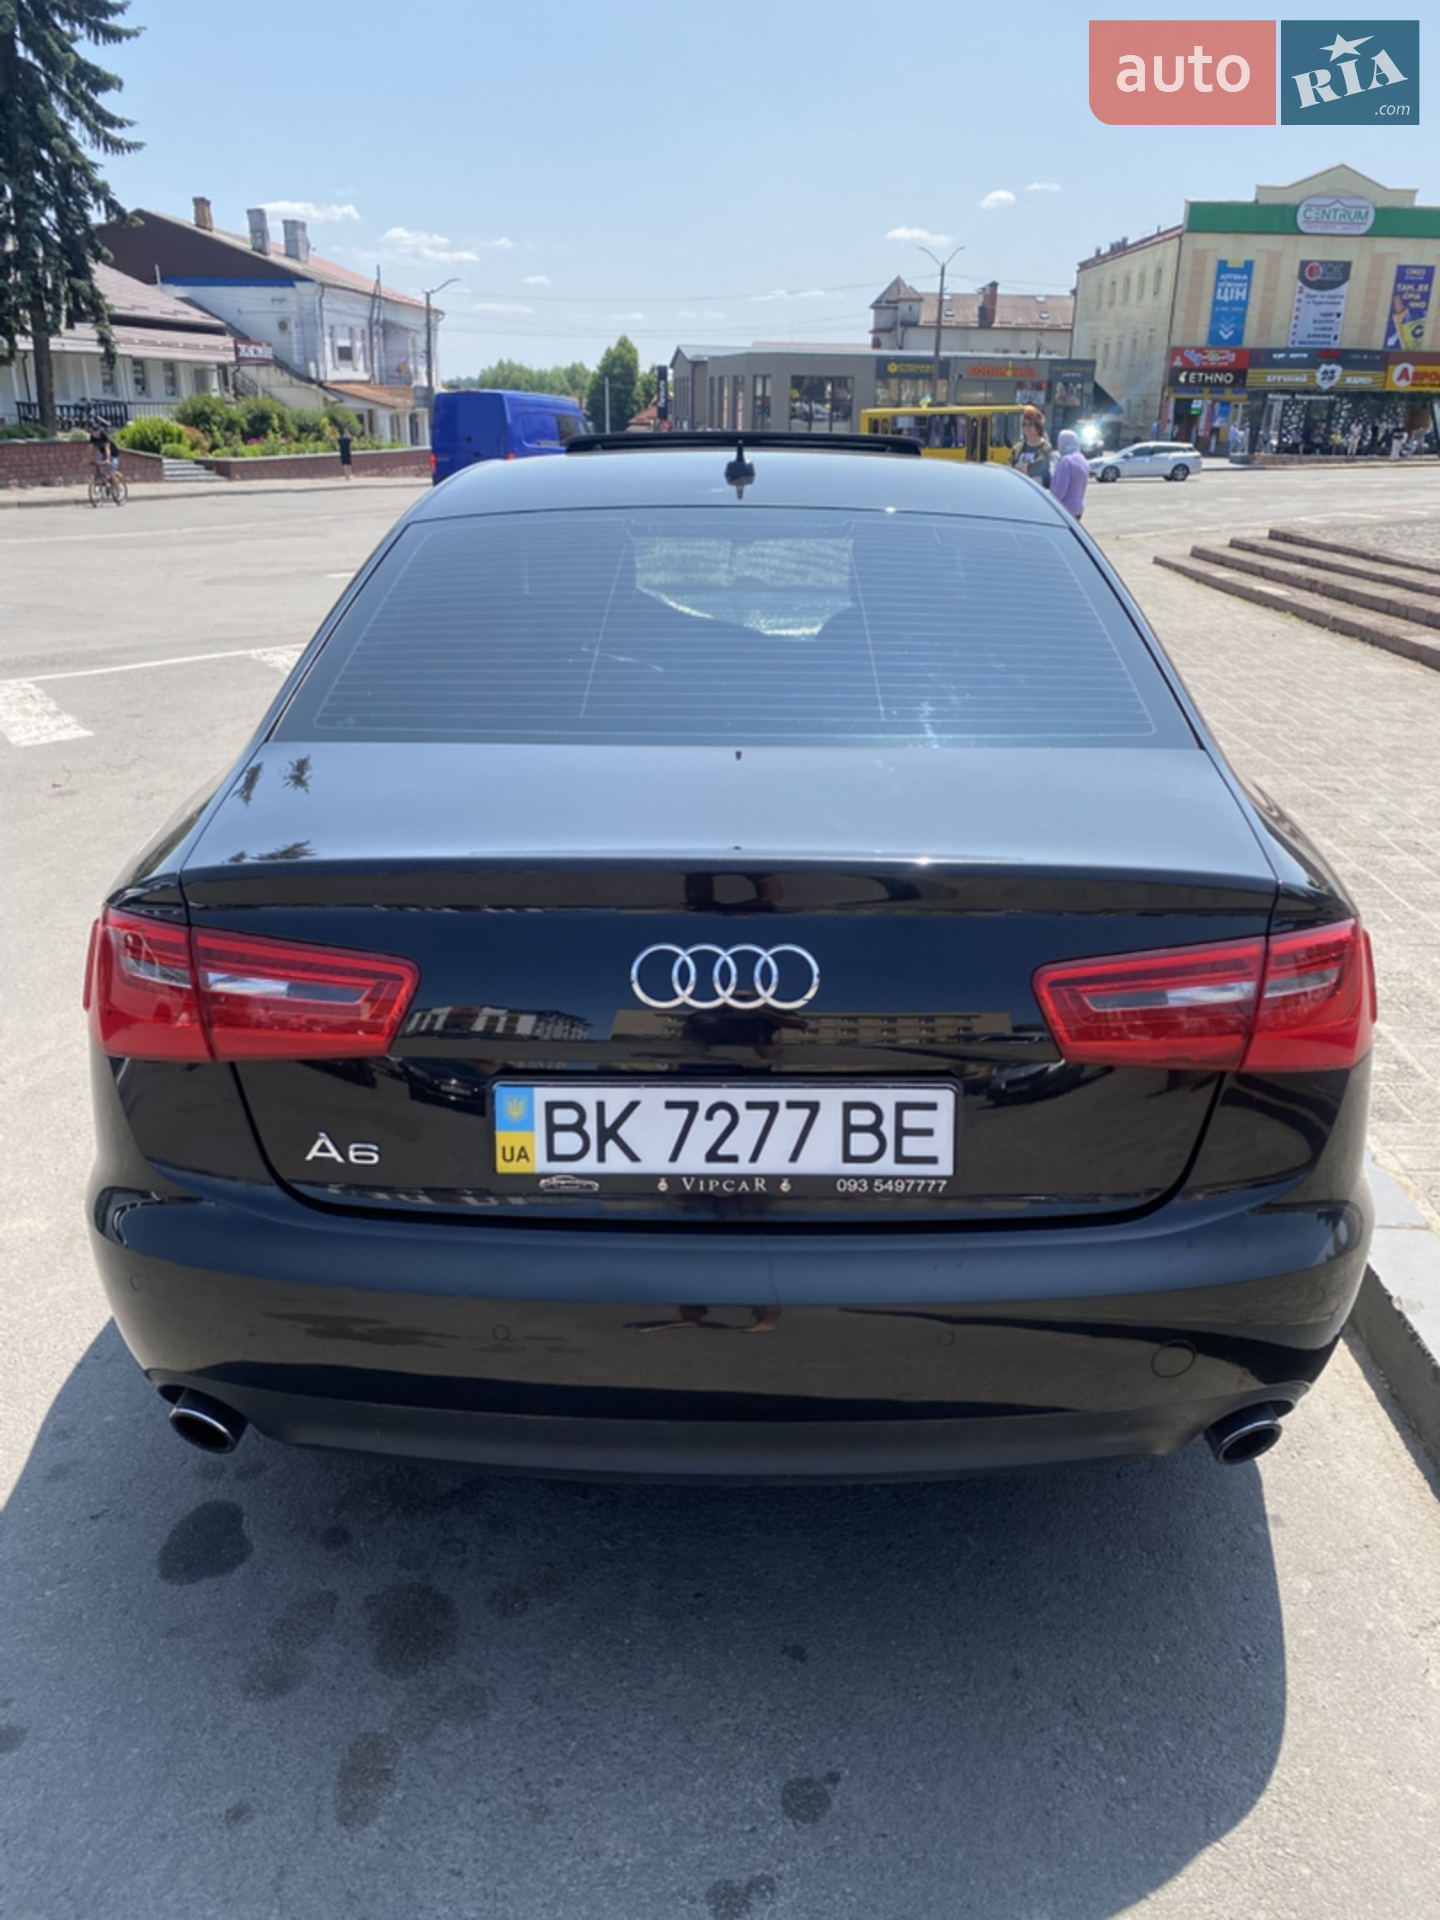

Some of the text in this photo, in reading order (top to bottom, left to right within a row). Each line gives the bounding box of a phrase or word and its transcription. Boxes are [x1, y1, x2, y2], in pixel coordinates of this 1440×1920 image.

[1303, 208, 1370, 222] CENTRUM
[1216, 288, 1247, 303] ЦІН
[1189, 372, 1234, 385] ETHNO
[544, 1100, 939, 1165] BK 7277 BE
[304, 1131, 380, 1165] A6
[501, 1145, 531, 1163] UA
[836, 1178, 948, 1193] 093 5497777
